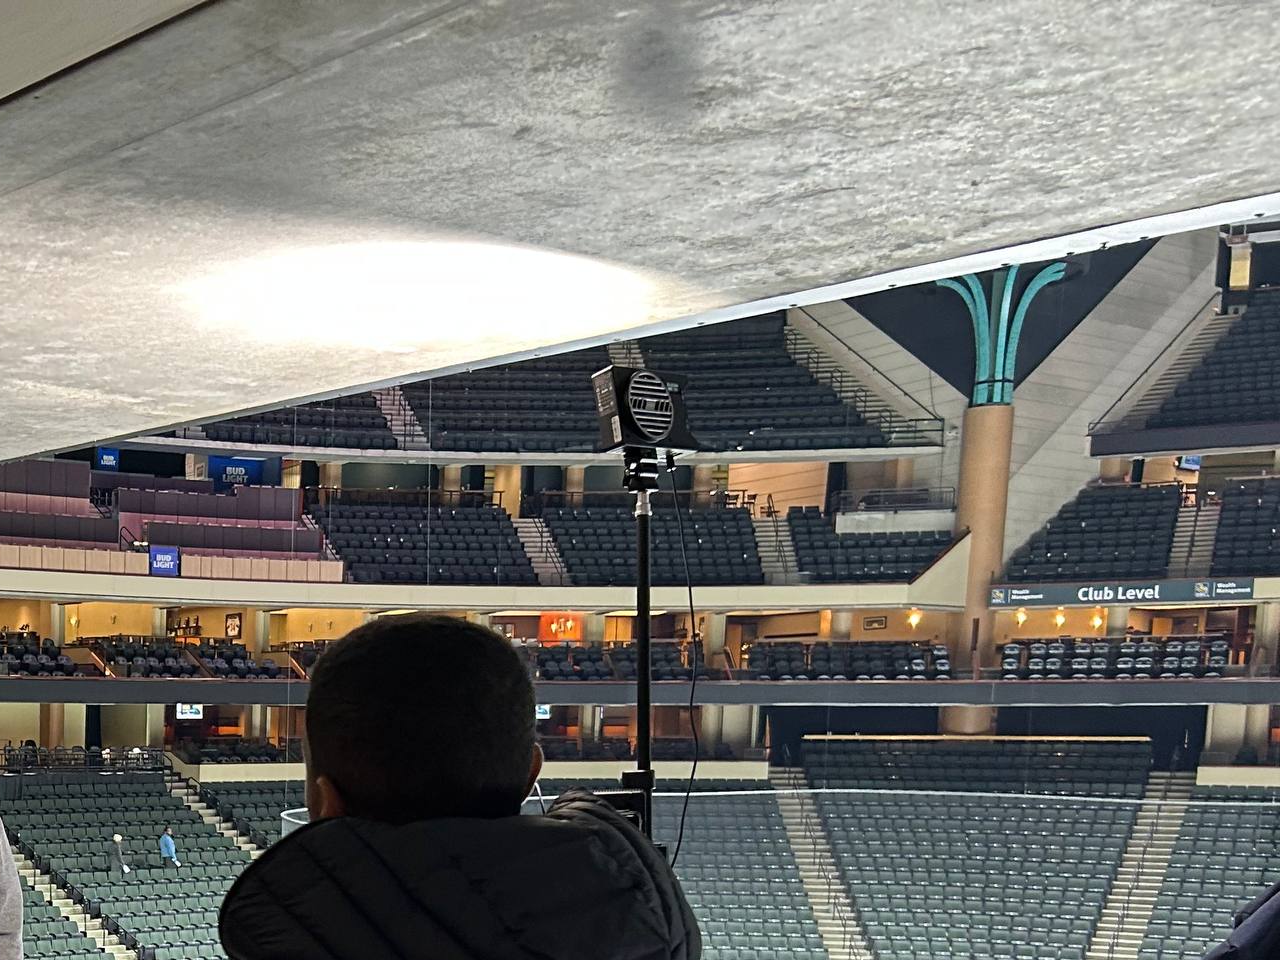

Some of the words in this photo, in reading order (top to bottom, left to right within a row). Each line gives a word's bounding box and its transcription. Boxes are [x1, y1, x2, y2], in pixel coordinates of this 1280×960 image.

[226, 466, 245, 475] BUD
[222, 474, 249, 484] LIGHT
[1078, 586, 1114, 601] Club
[1117, 584, 1160, 600] Level
